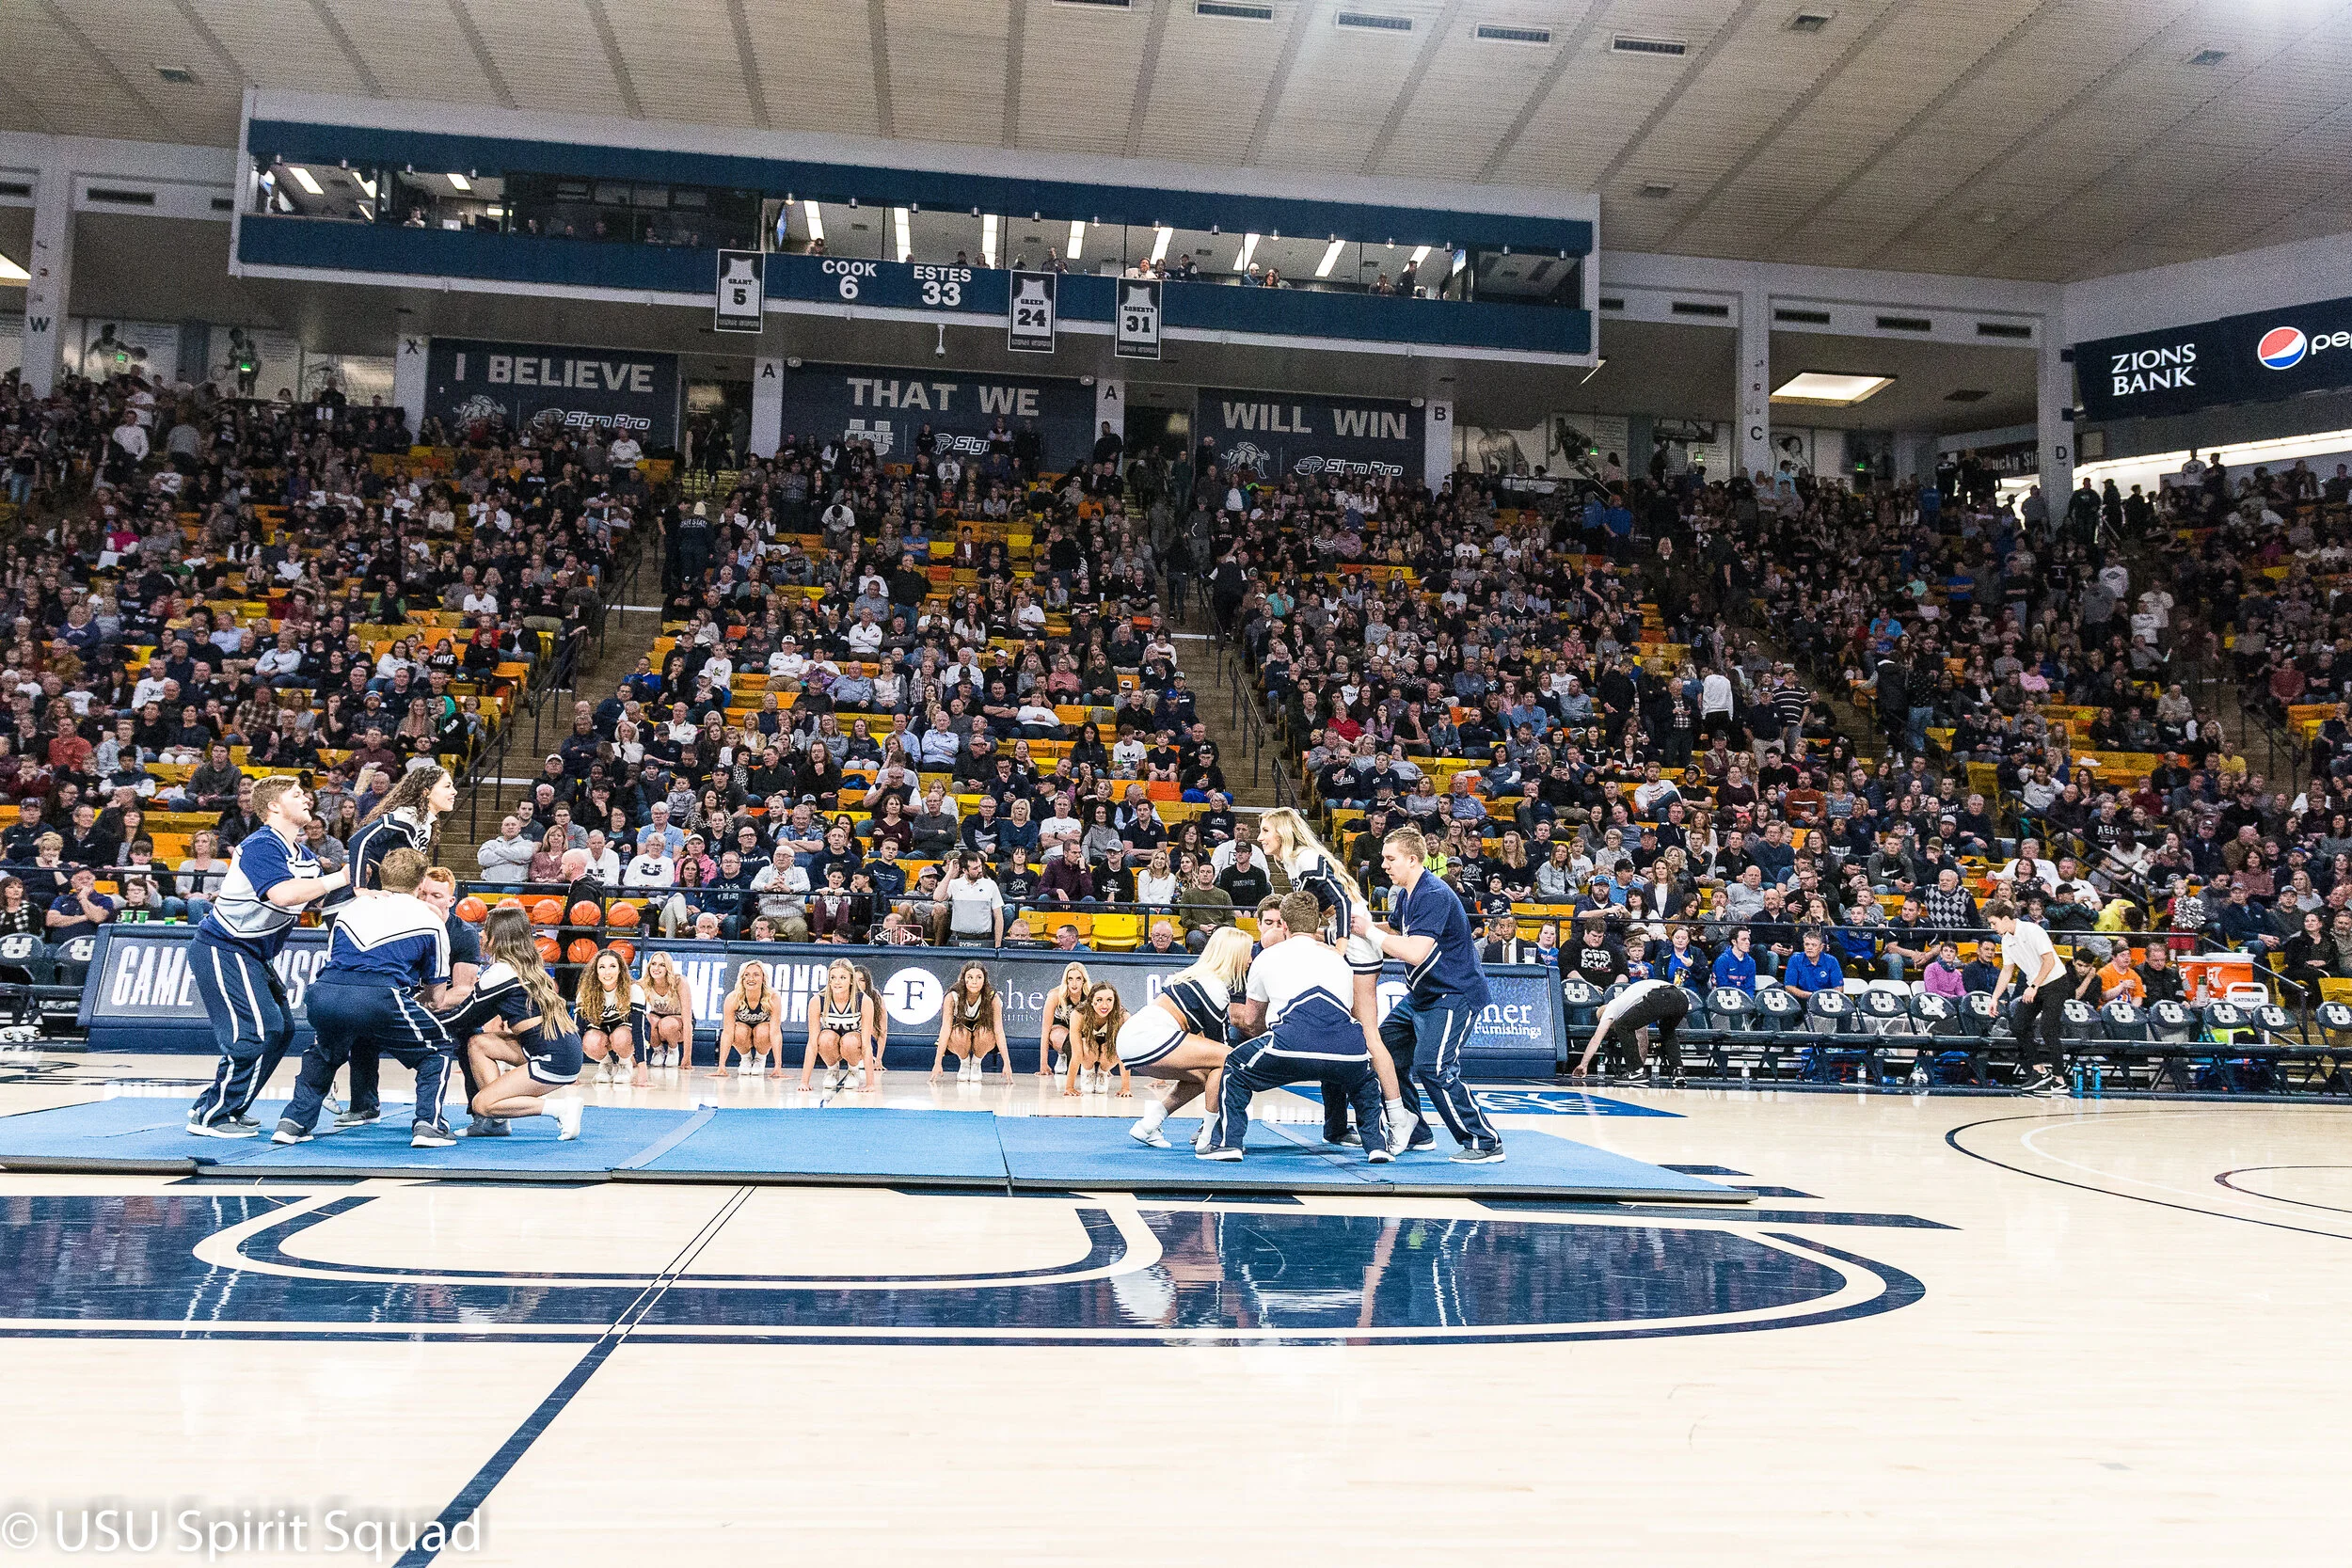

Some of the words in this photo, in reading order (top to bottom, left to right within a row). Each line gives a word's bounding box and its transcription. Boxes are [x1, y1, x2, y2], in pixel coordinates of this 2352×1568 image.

[822, 260, 877, 277] COOK
[913, 265, 972, 282] ESTES
[839, 276, 858, 299] 6
[922, 281, 961, 306] 33
[733, 288, 746, 306] 5
[29, 316, 50, 332] W
[1018, 309, 1046, 326] 24
[1126, 315, 1150, 333] 31
[405, 339, 419, 355] X
[2311, 330, 2352, 355] pe
[2111, 343, 2197, 373] ZIONS
[455, 353, 466, 381] I
[487, 355, 655, 392] BELIEVE
[761, 363, 776, 378] A
[2112, 365, 2196, 396] BANK
[847, 377, 957, 411] THAT
[978, 385, 1040, 417] WE
[1104, 385, 1118, 400] A
[1222, 402, 1312, 434] WILL
[1333, 408, 1407, 439] WIN
[1434, 406, 1447, 420] B
[1750, 426, 1763, 440] C
[2056, 446, 2067, 459] D
[902, 980, 925, 1010] F
